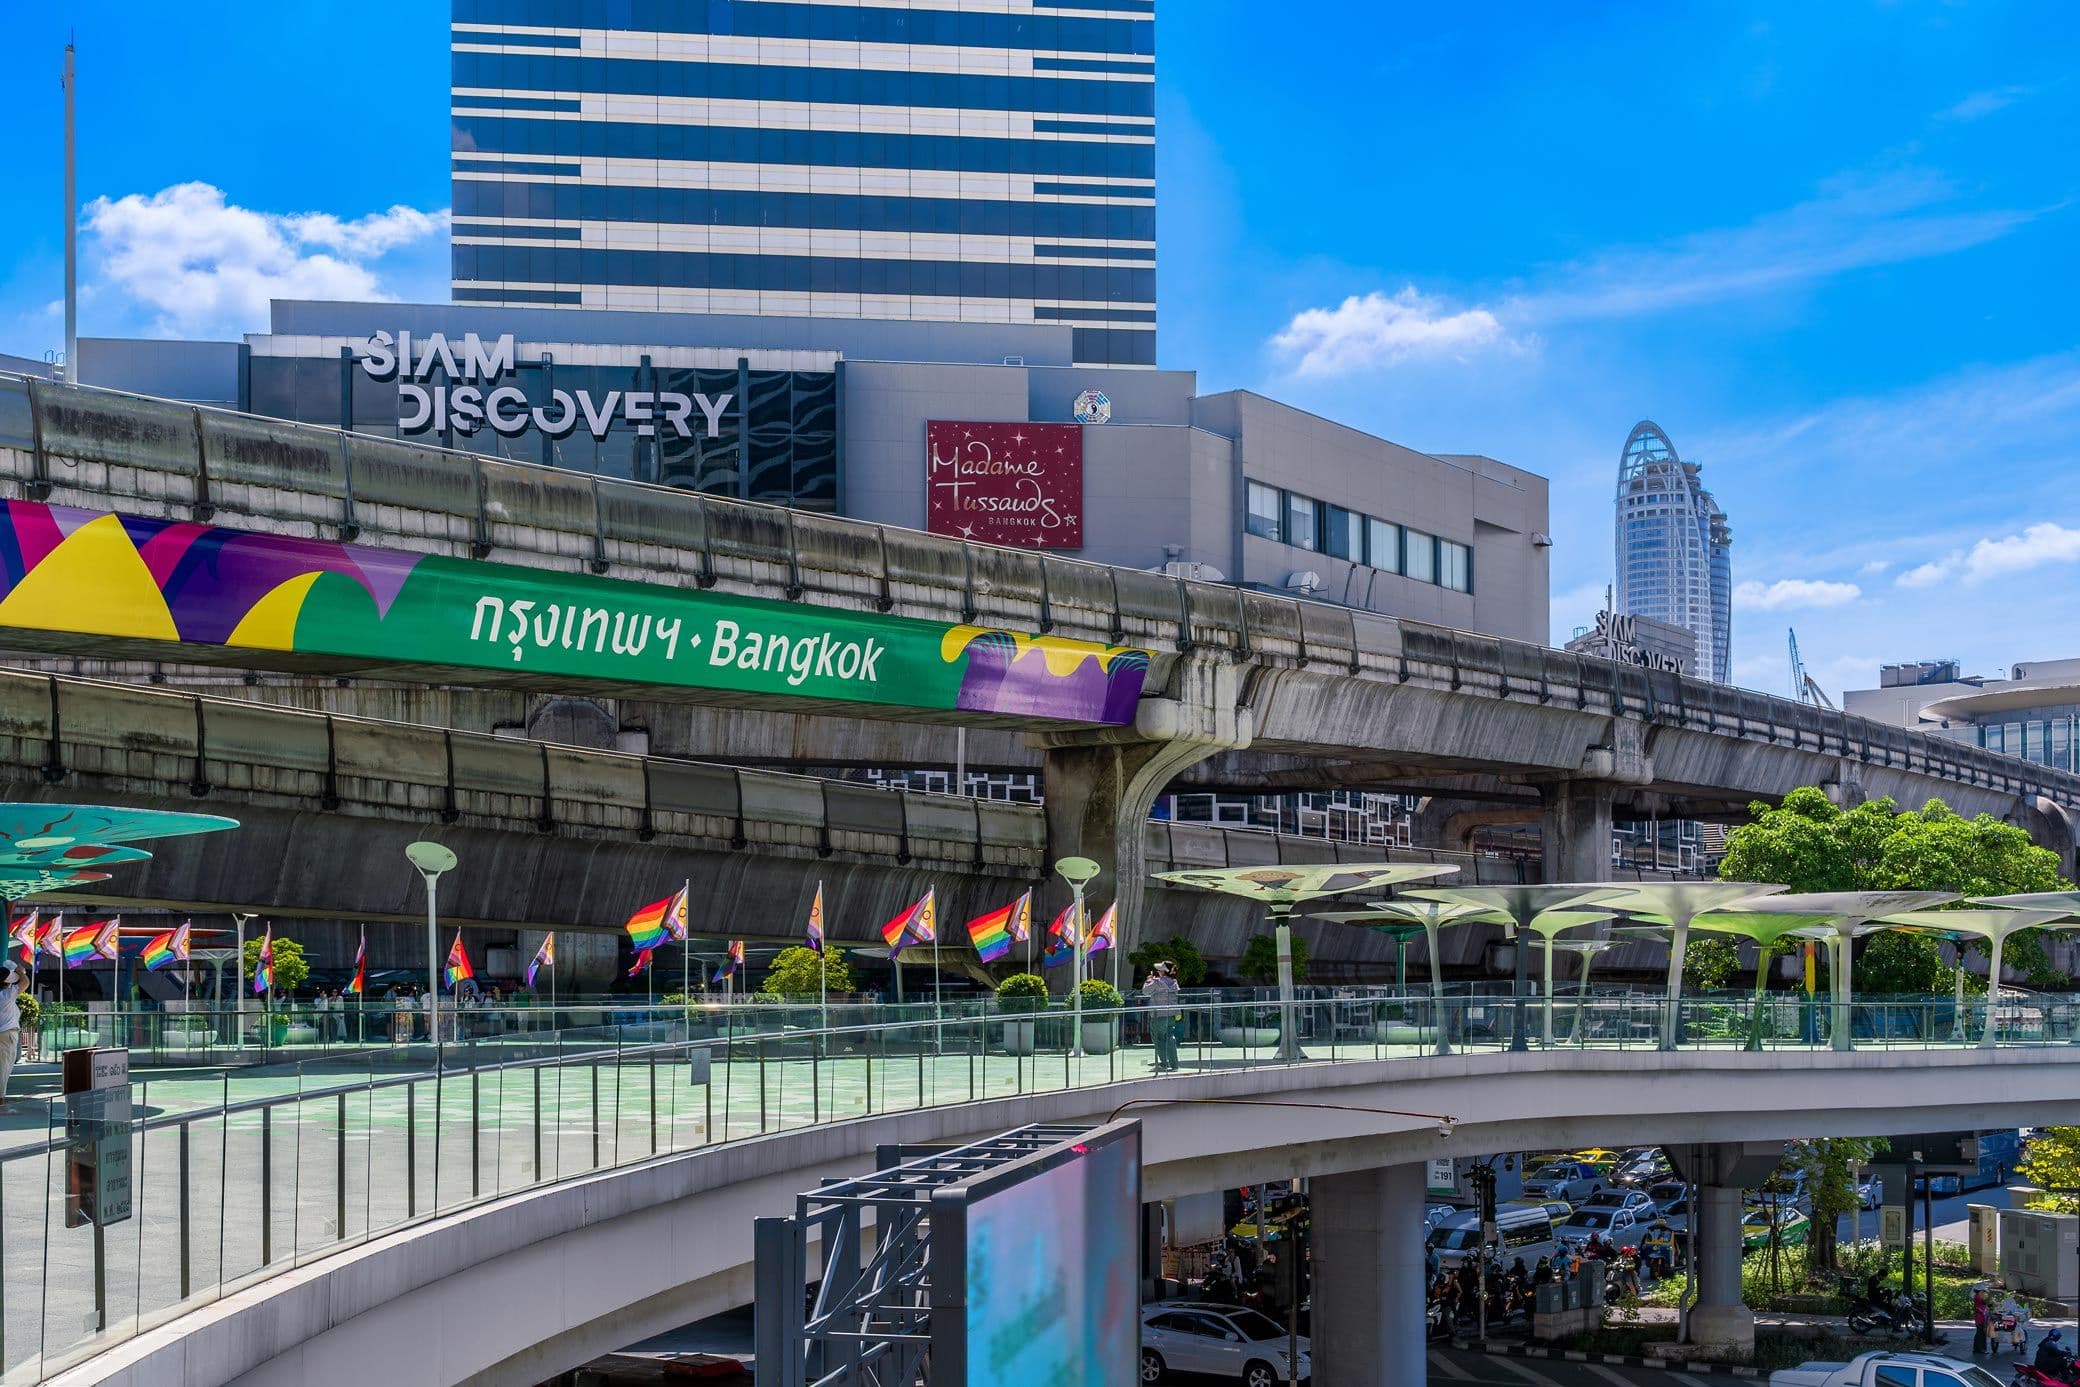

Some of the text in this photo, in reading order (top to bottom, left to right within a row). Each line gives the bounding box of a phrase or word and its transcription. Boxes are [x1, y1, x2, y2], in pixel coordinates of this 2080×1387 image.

[361, 330, 514, 379] SIAM
[400, 384, 733, 438] DISCOVERY
[933, 441, 1045, 478] Madame
[936, 478, 1061, 528] Tussauds
[988, 517, 1036, 526] BANGKOK
[470, 596, 885, 686] กรุงเทพฯ Bangkok
[1596, 609, 1636, 643] SAM
[1440, 1171, 1452, 1181] 191
